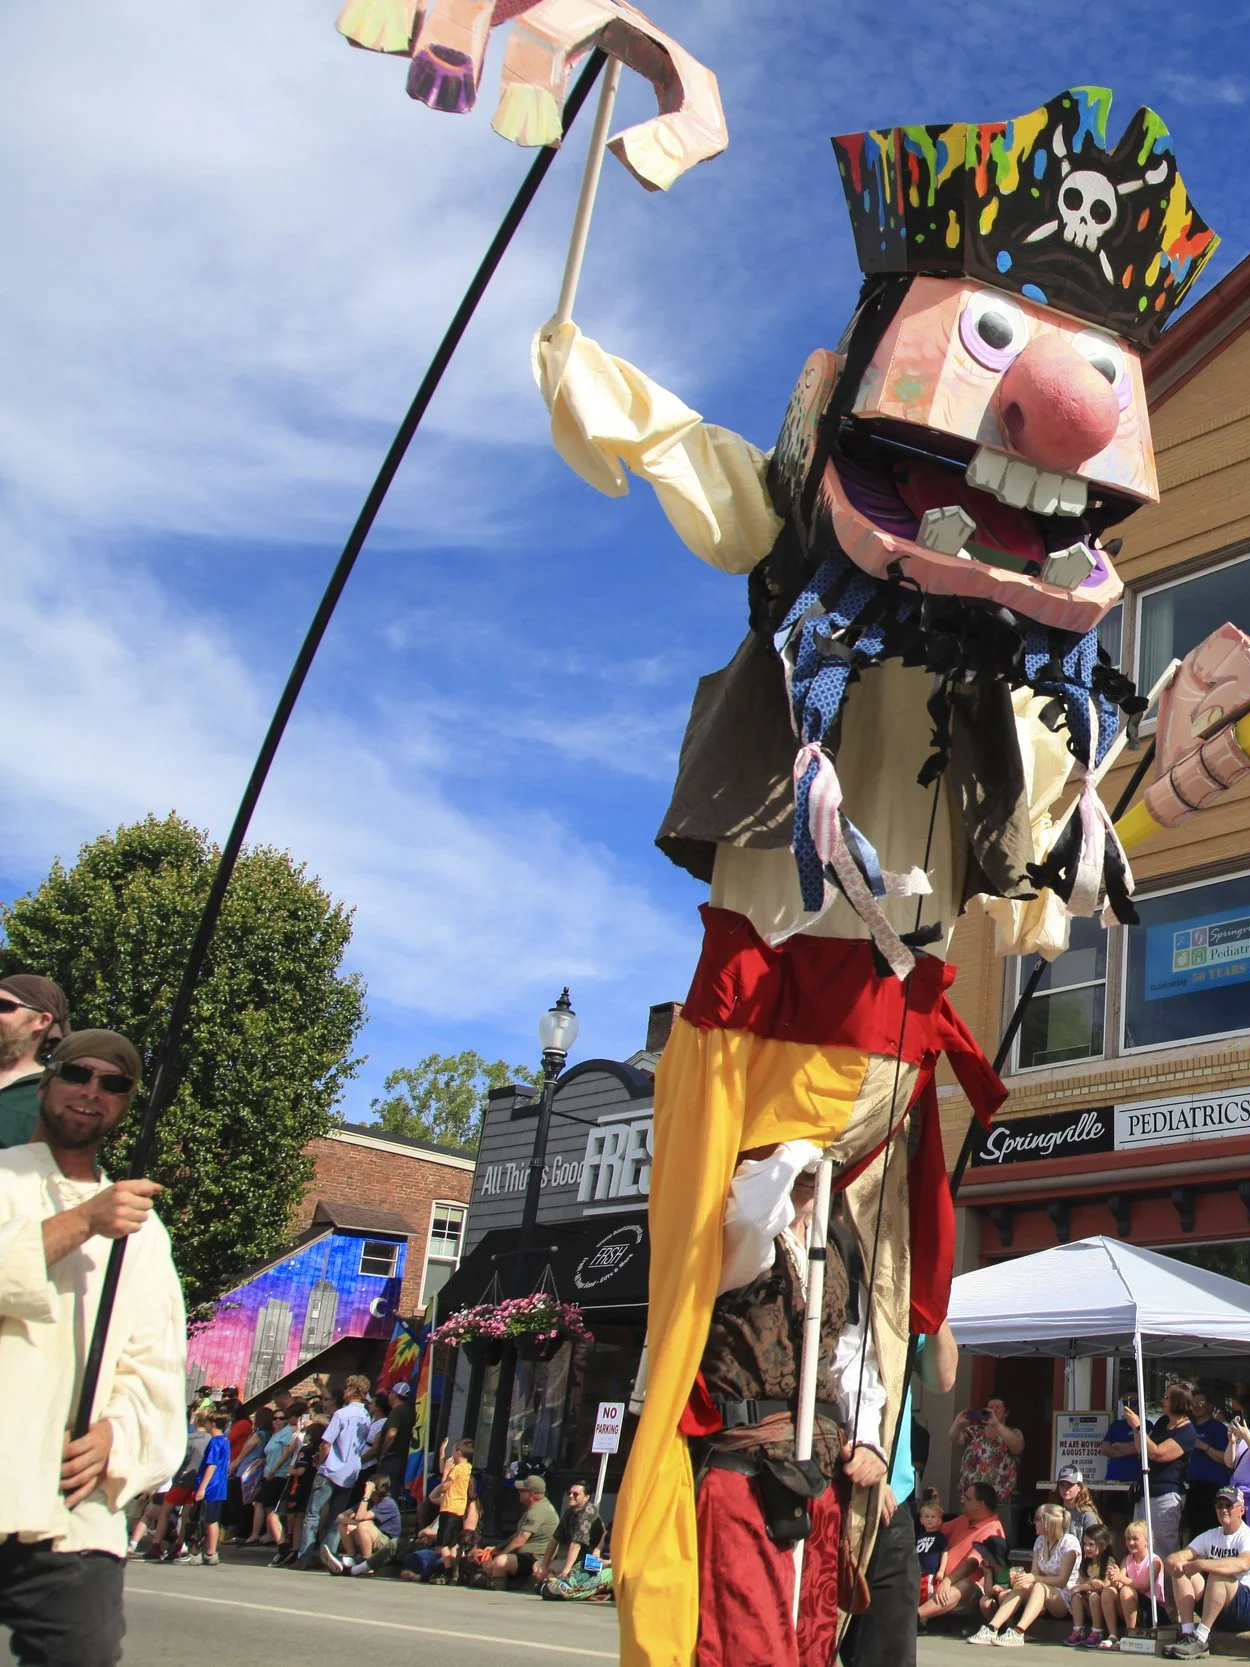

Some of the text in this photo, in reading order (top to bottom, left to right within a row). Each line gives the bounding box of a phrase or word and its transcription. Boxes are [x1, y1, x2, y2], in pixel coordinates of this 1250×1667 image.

[979, 1111, 1105, 1163] Springville
[1128, 1099, 1250, 1136] PEDIATRICS
[481, 1165, 502, 1196] All
[589, 1245, 628, 1266] FRSH
[602, 1407, 618, 1419] NO
[595, 1424, 619, 1435] PARKING
[1059, 1440, 1103, 1448] WE ARE MOVIN
